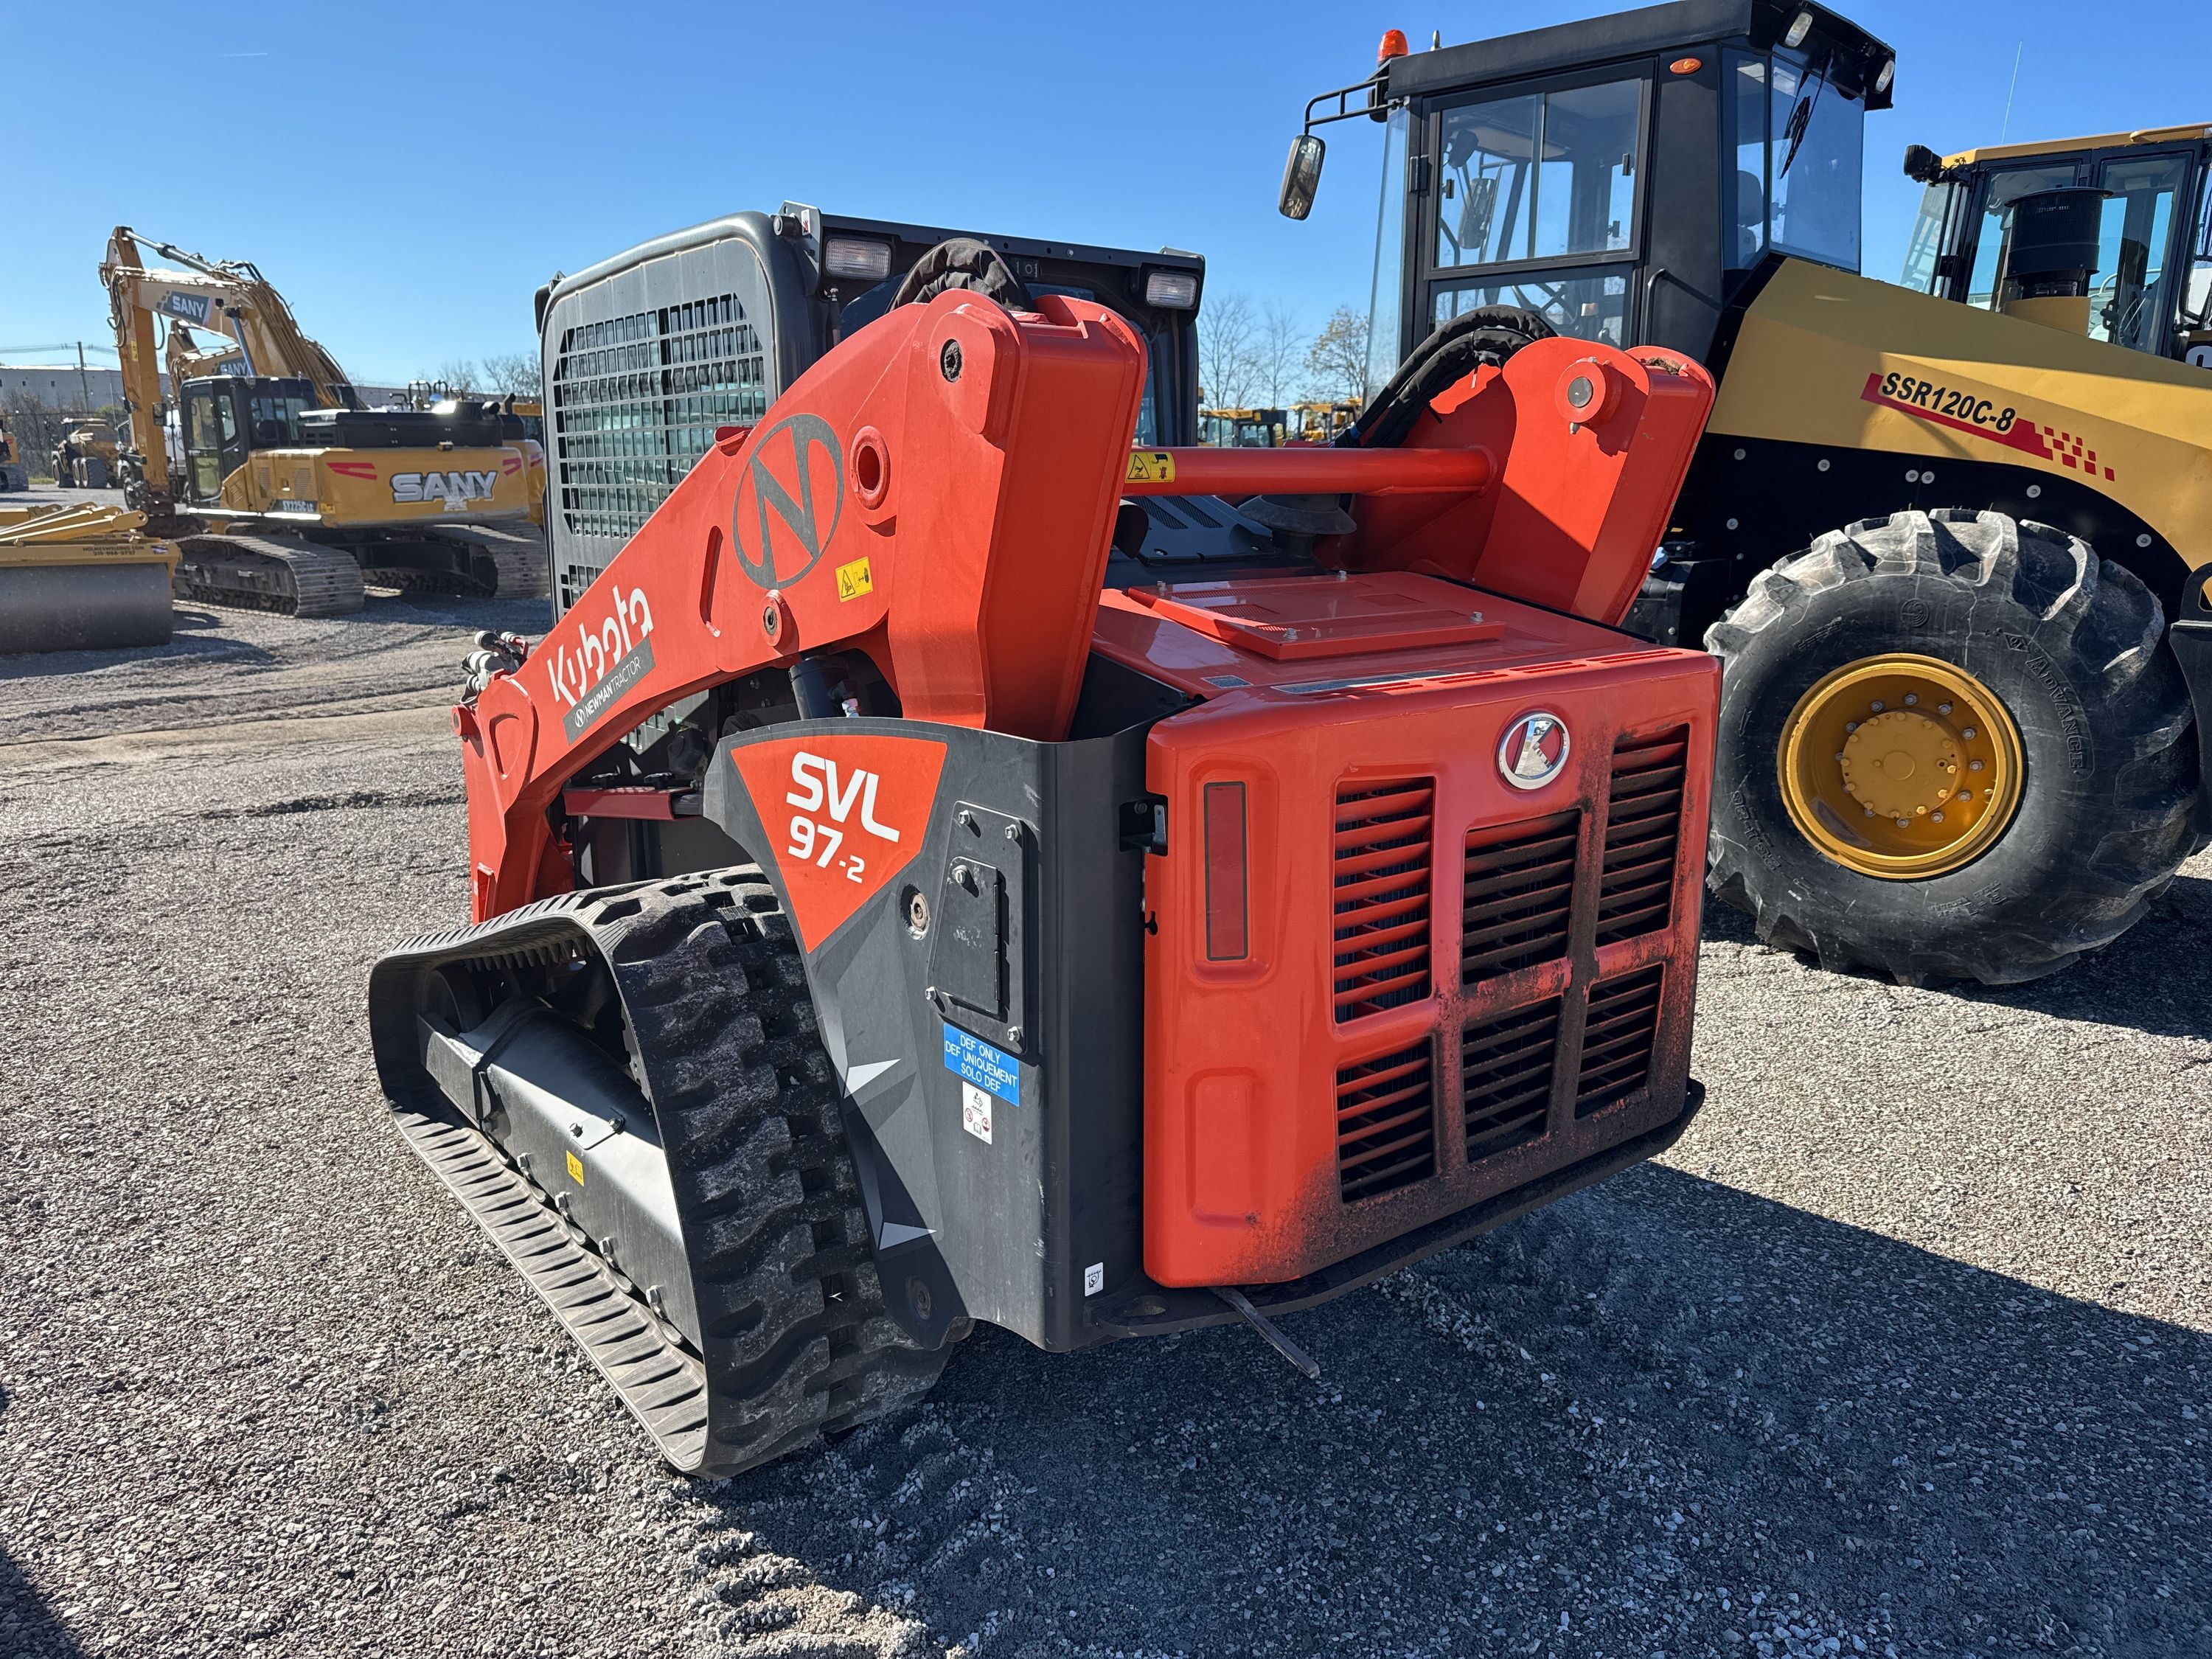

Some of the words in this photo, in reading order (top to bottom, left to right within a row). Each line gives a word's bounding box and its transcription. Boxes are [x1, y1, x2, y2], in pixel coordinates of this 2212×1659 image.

[172, 296, 204, 318] SANY
[220, 362, 247, 376] SANY
[1882, 372, 2016, 432] SSR120C-8
[391, 470, 498, 502] SANY
[547, 585, 654, 708] Kubota
[2025, 655, 2084, 769] ADVANCE
[786, 751, 900, 844] SVL
[945, 1040, 961, 1057] DEF
[963, 1050, 1018, 1088] UNIQUEMENT
[960, 1034, 976, 1051] DEF
[978, 1045, 1000, 1065] ONLY
[961, 1064, 982, 1082] SOLO
[984, 1077, 1001, 1092] DEF
